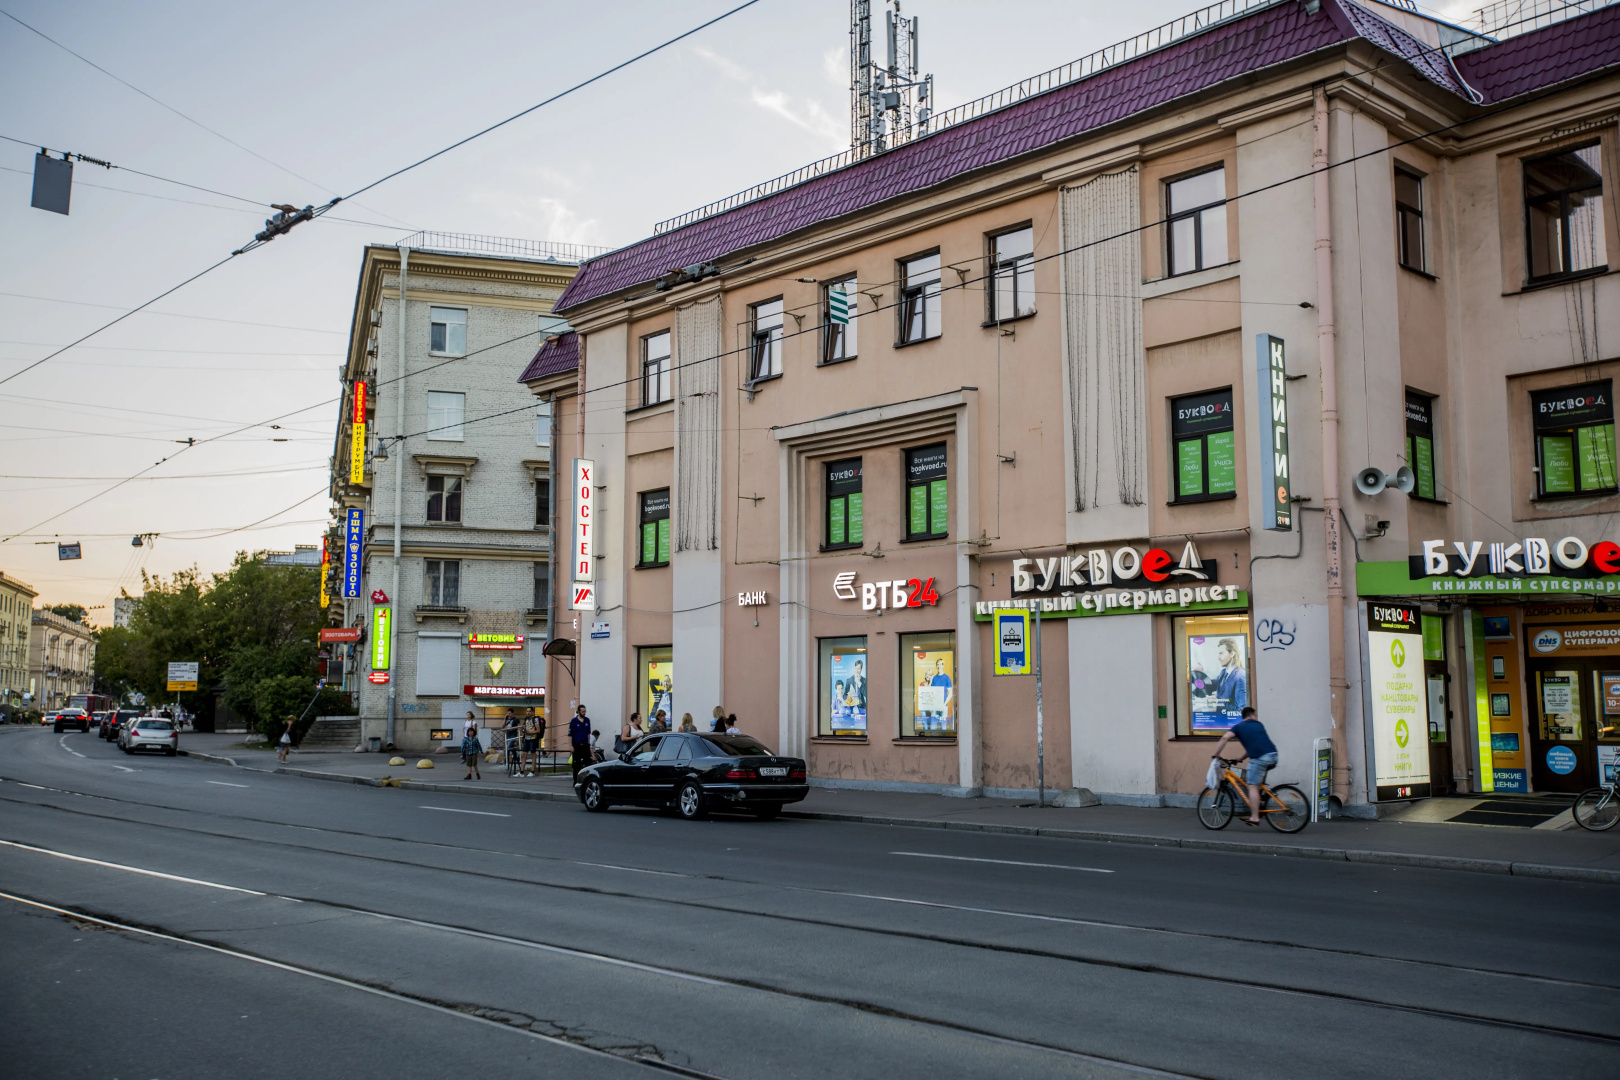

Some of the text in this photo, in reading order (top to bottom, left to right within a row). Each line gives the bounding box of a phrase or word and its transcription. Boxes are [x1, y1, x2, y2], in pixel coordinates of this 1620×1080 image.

[1271, 341, 1288, 478] КНИГИ
[354, 425, 362, 481] ИНСТРУМЕНТ
[351, 511, 360, 541] ЯШМА
[579, 467, 590, 574] ХОСТЕЛ
[349, 553, 358, 597] ЗОЛОТО
[1432, 577, 1620, 592] книжный супермар
[738, 591, 767, 606] БАНК
[862, 576, 938, 611] ВТБ24
[1081, 584, 1240, 613] супермаркет
[1525, 604, 1620, 617] ДОБРО ПОЖАОВ
[1381, 693, 1418, 703] КАНЦТОВАРЫ
[1386, 681, 1413, 691] ПОДАРКИ
[1385, 705, 1416, 714] СУВЕНИРЫ
